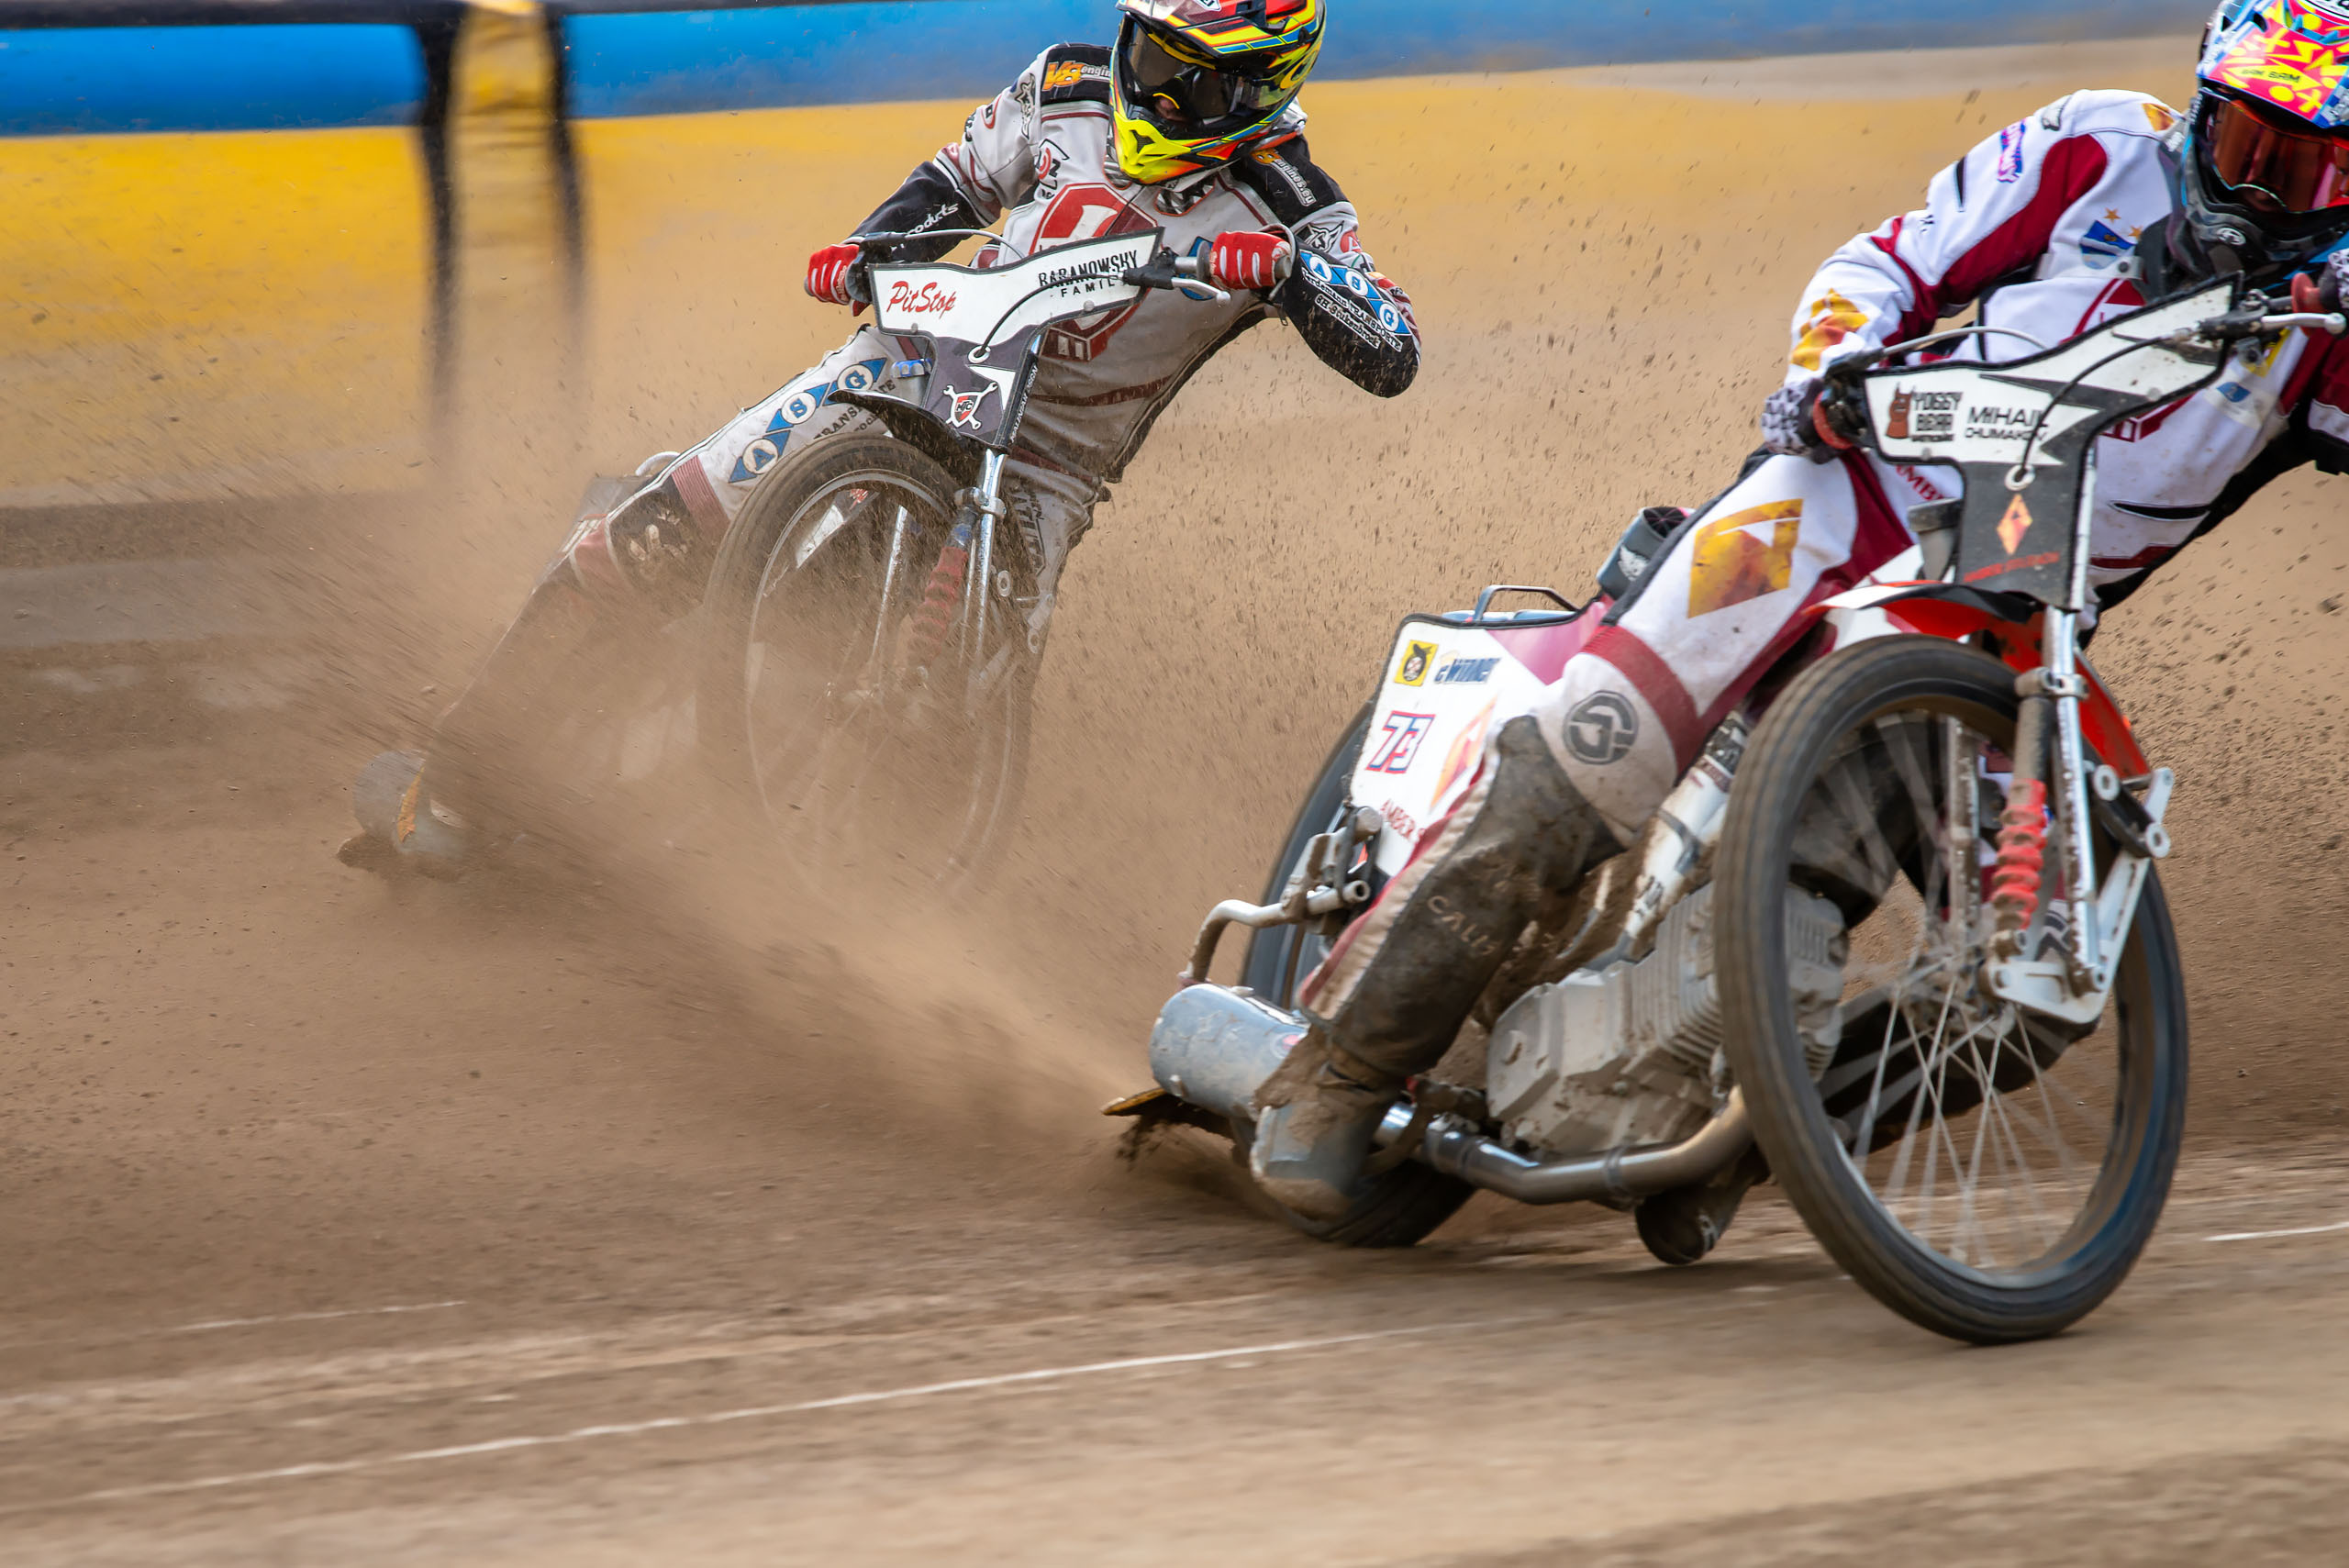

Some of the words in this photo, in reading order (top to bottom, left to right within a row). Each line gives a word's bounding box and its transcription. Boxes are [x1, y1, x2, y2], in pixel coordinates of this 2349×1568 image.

[1041, 61, 1083, 91] V8
[906, 203, 959, 235] roducts
[886, 280, 956, 319] PitStop
[1061, 274, 1121, 298] FAMIL
[1365, 710, 1436, 773] 73
